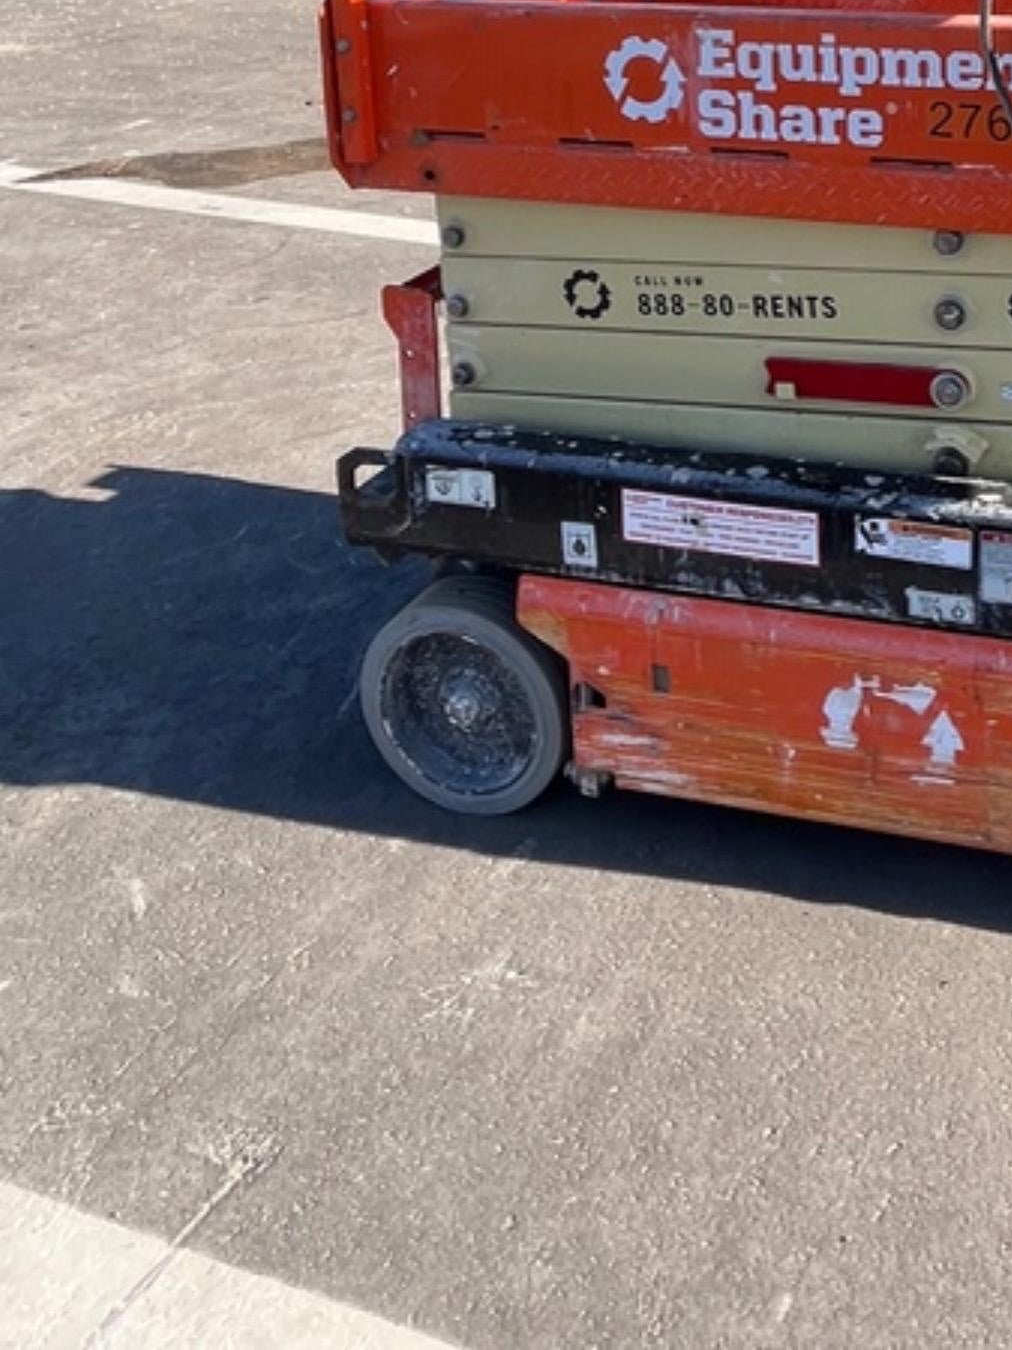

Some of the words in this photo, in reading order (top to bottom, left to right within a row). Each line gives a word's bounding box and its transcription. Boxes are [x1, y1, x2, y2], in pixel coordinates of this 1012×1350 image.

[696, 88, 885, 148] Share
[634, 274, 668, 287] CALL
[673, 275, 704, 287] NOW
[637, 292, 838, 319] 888-80-RENTS
